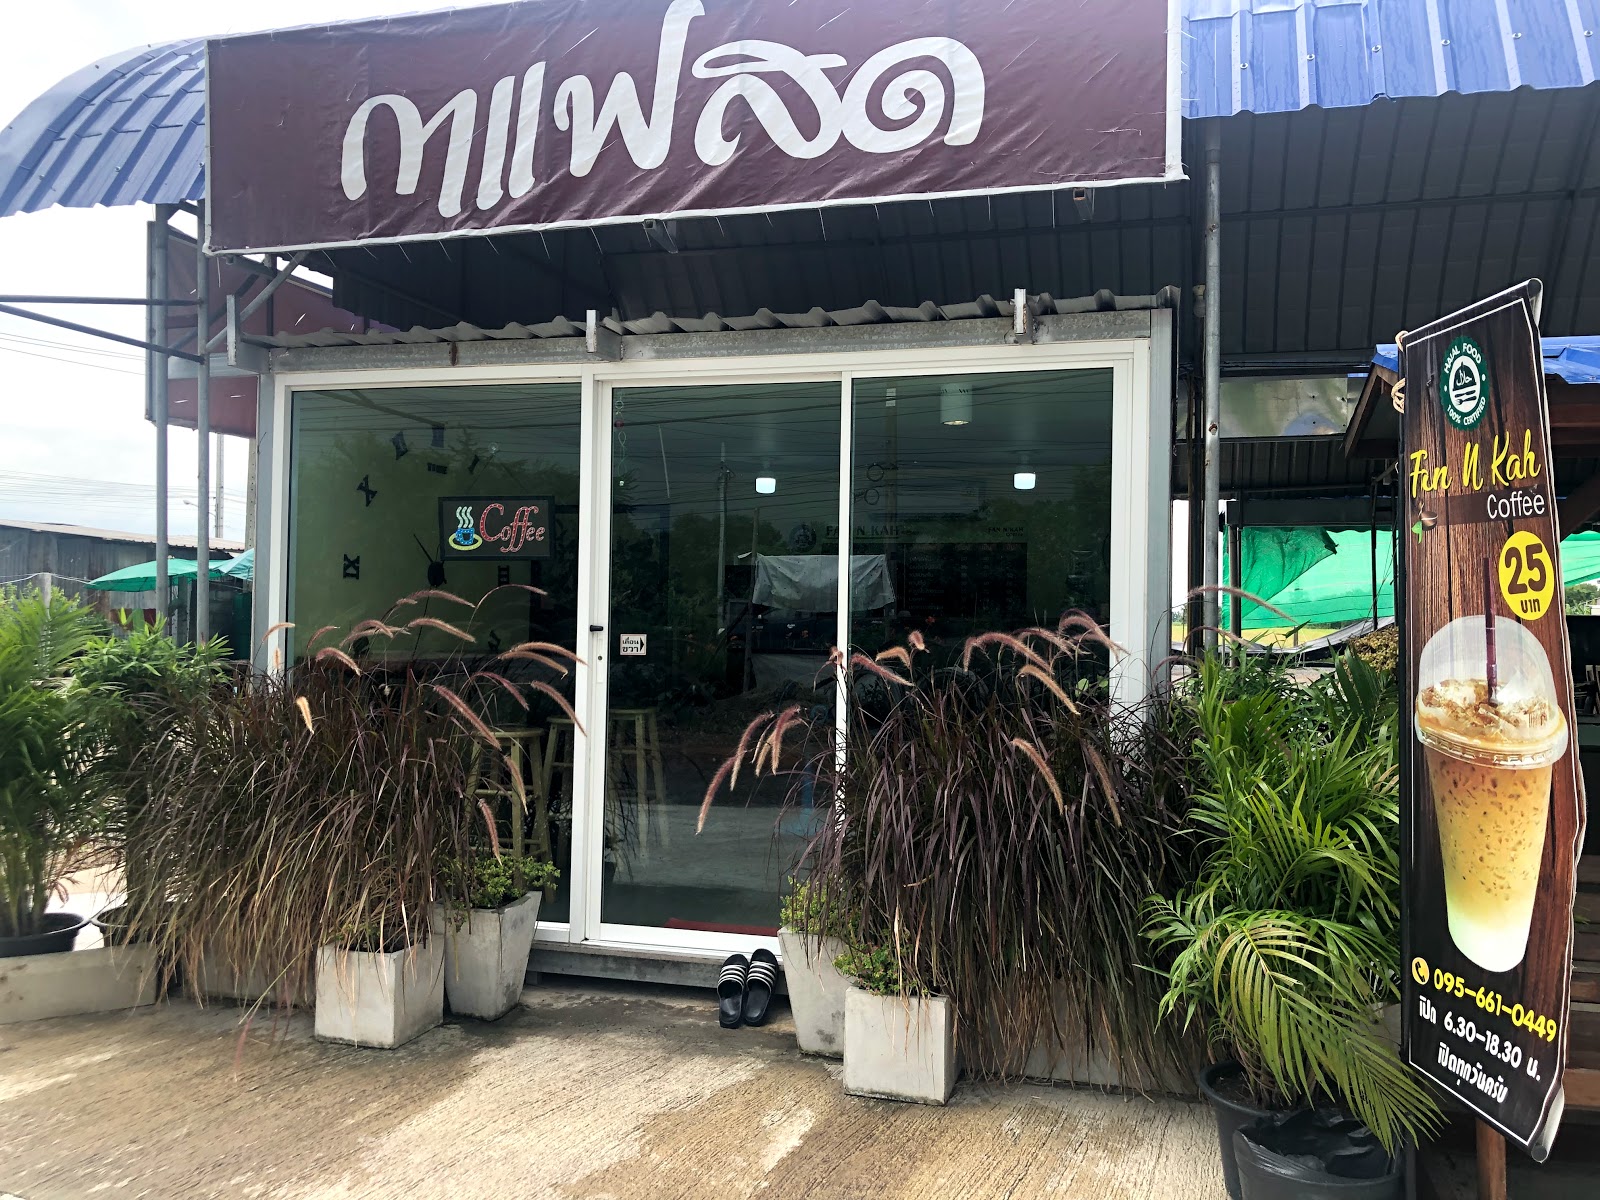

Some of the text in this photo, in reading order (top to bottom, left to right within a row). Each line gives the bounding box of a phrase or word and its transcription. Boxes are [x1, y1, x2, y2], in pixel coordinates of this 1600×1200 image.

[341, 0, 985, 218] กาแฟสด
[1443, 342, 1482, 374] HALAL FOOD
[1446, 396, 1486, 426] 100% CERTIFIED
[1462, 441, 1484, 491] N
[1491, 428, 1541, 488] Kah
[479, 503, 546, 553] Coffee
[1487, 490, 1545, 519] Coffee
[1504, 543, 1547, 595] 25
[1520, 597, 1541, 614] บาท
[1433, 968, 1557, 1042] 095-661-0449
[1444, 1011, 1522, 1068] 6.30-18.30
[1526, 1057, 1541, 1081] น.
[1437, 1041, 1509, 1104] เปิดทุกวันครับ
